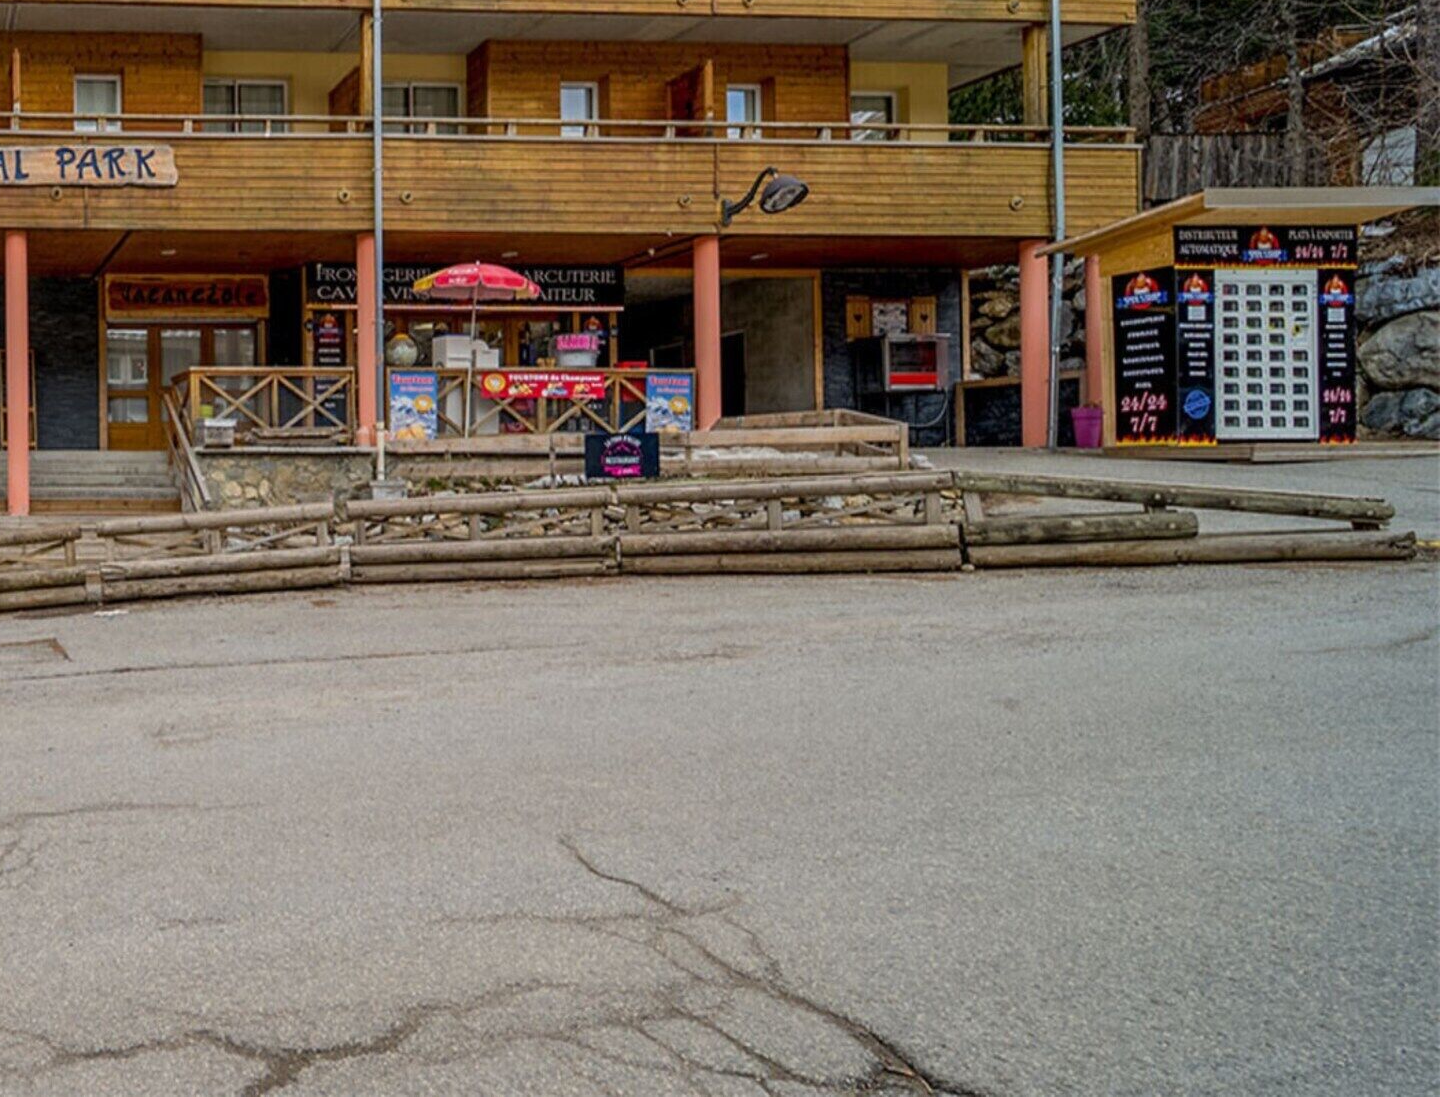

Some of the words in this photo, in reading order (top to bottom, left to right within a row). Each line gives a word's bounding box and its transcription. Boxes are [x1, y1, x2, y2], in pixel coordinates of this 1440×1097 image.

[55, 147, 156, 179] PARK
[1178, 230, 1238, 240] DISTRIBUTEUR
[1179, 244, 1239, 257] AUTOMATIQUE
[316, 263, 431, 282] FROGERIE
[317, 286, 358, 299] CAV
[1121, 391, 1168, 412] 24/24
[1130, 412, 1158, 432] 7/7
[1329, 406, 1346, 423] 7/7
